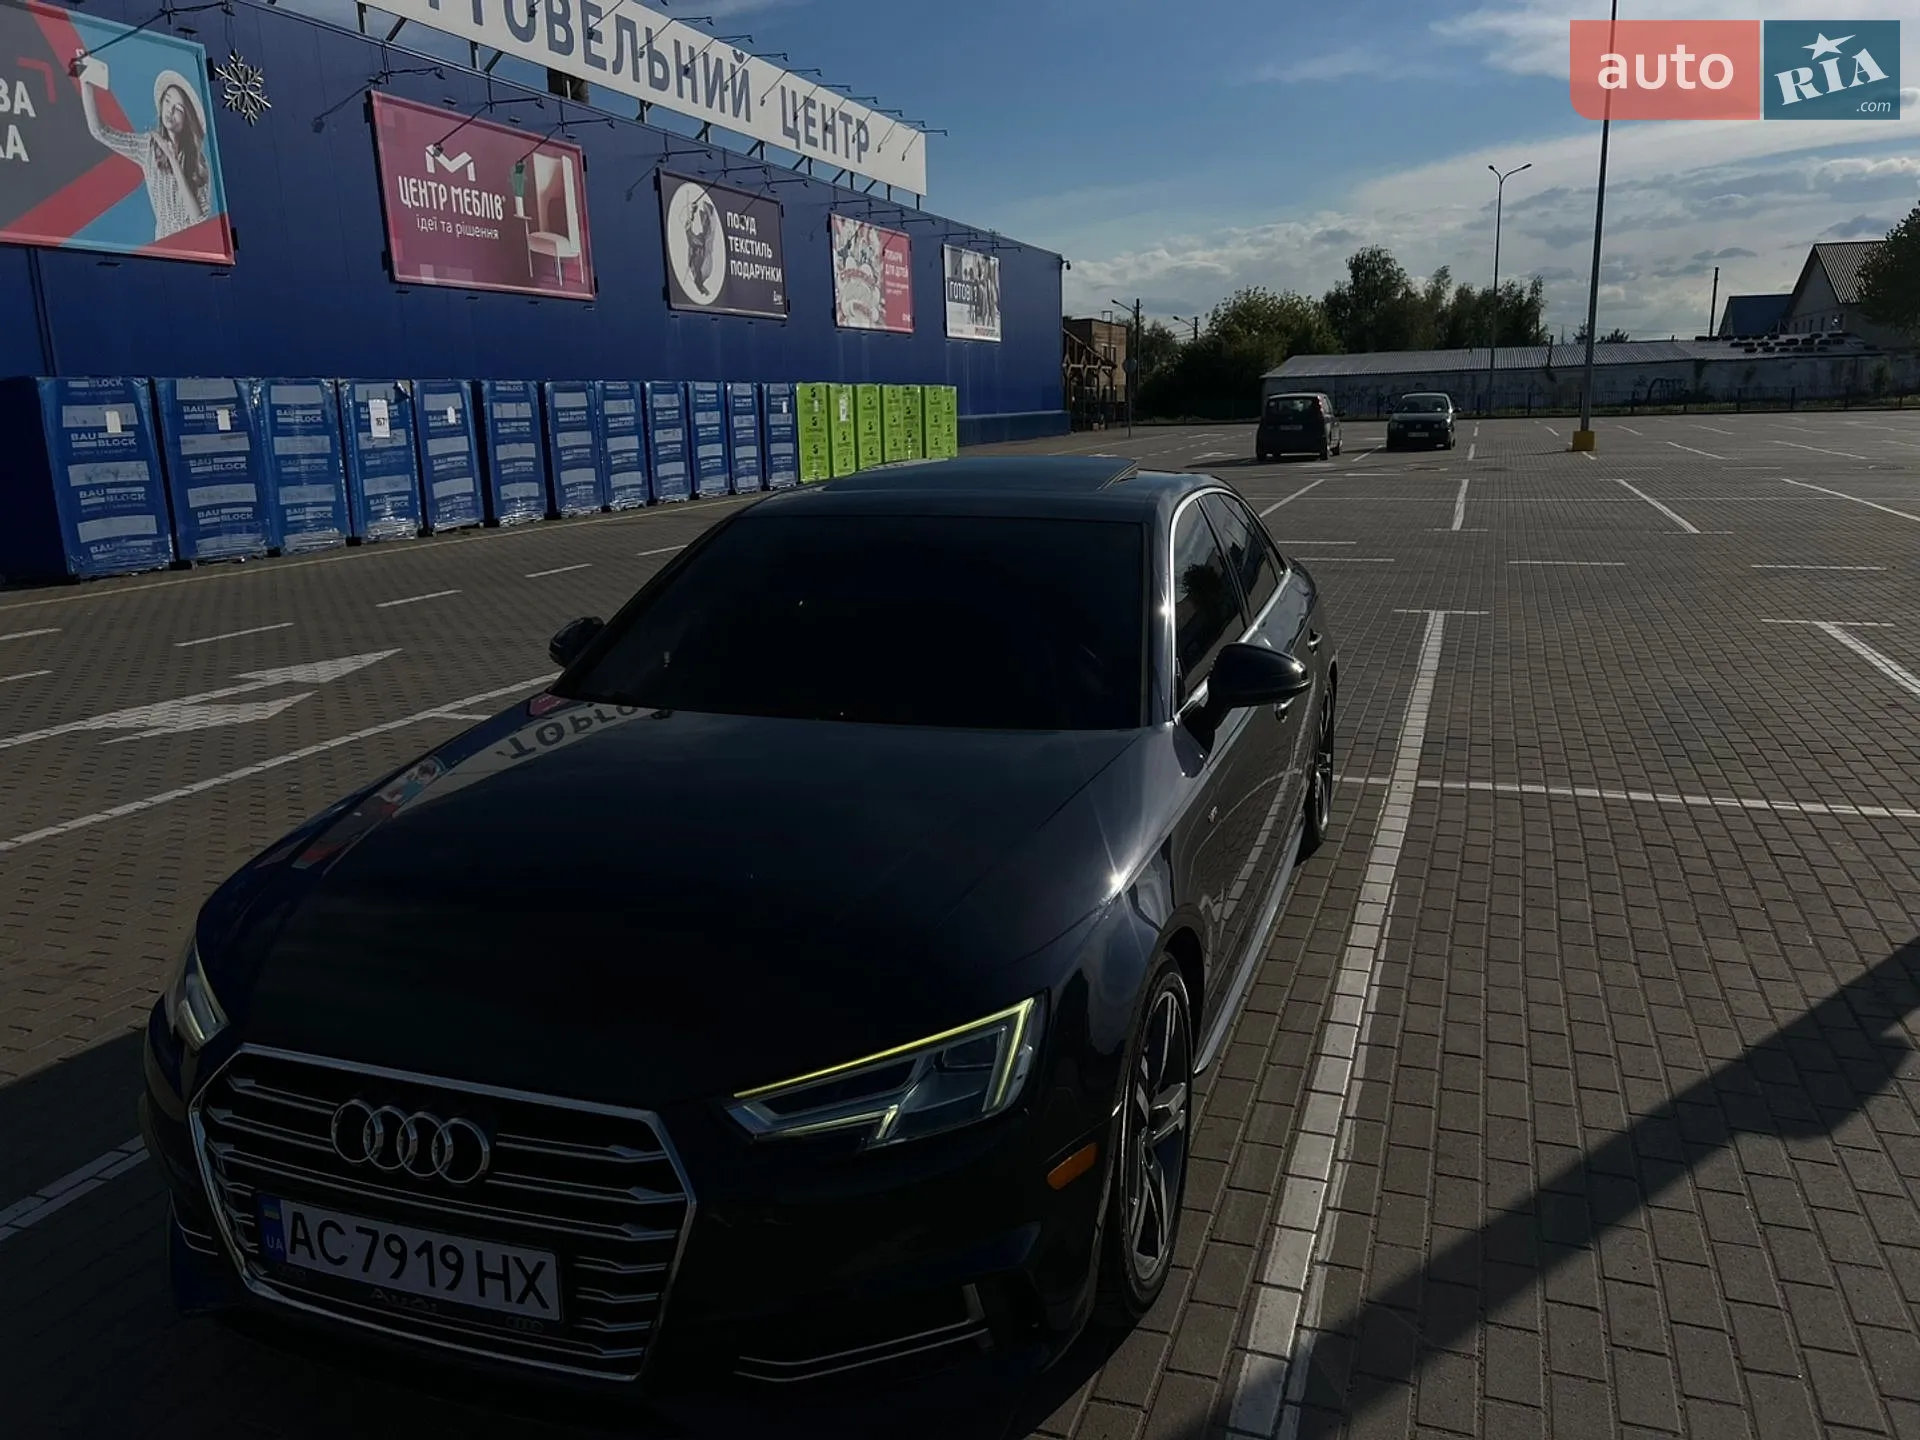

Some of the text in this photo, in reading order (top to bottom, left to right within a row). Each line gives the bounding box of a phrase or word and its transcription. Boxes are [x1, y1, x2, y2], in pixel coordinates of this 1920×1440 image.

[431, 0, 872, 164] ОВЕЛЬНИЙ ЦЕНТР
[398, 175, 504, 221] ЦЕНТР МЕБЛІВ
[416, 214, 499, 240] ідеї та рішення
[728, 235, 773, 259] ТЕКСТИЛЬ
[730, 260, 783, 283] ПОДАРУНКИ
[70, 432, 97, 442] BAU
[97, 438, 137, 448] BLOCK
[189, 458, 212, 468] BAU
[213, 463, 247, 472] BLOCK
[79, 488, 105, 499] BAU
[106, 494, 146, 503] BLOCK
[198, 509, 220, 518] BAU
[220, 513, 253, 522] BLOCK
[266, 1235, 284, 1251] UA
